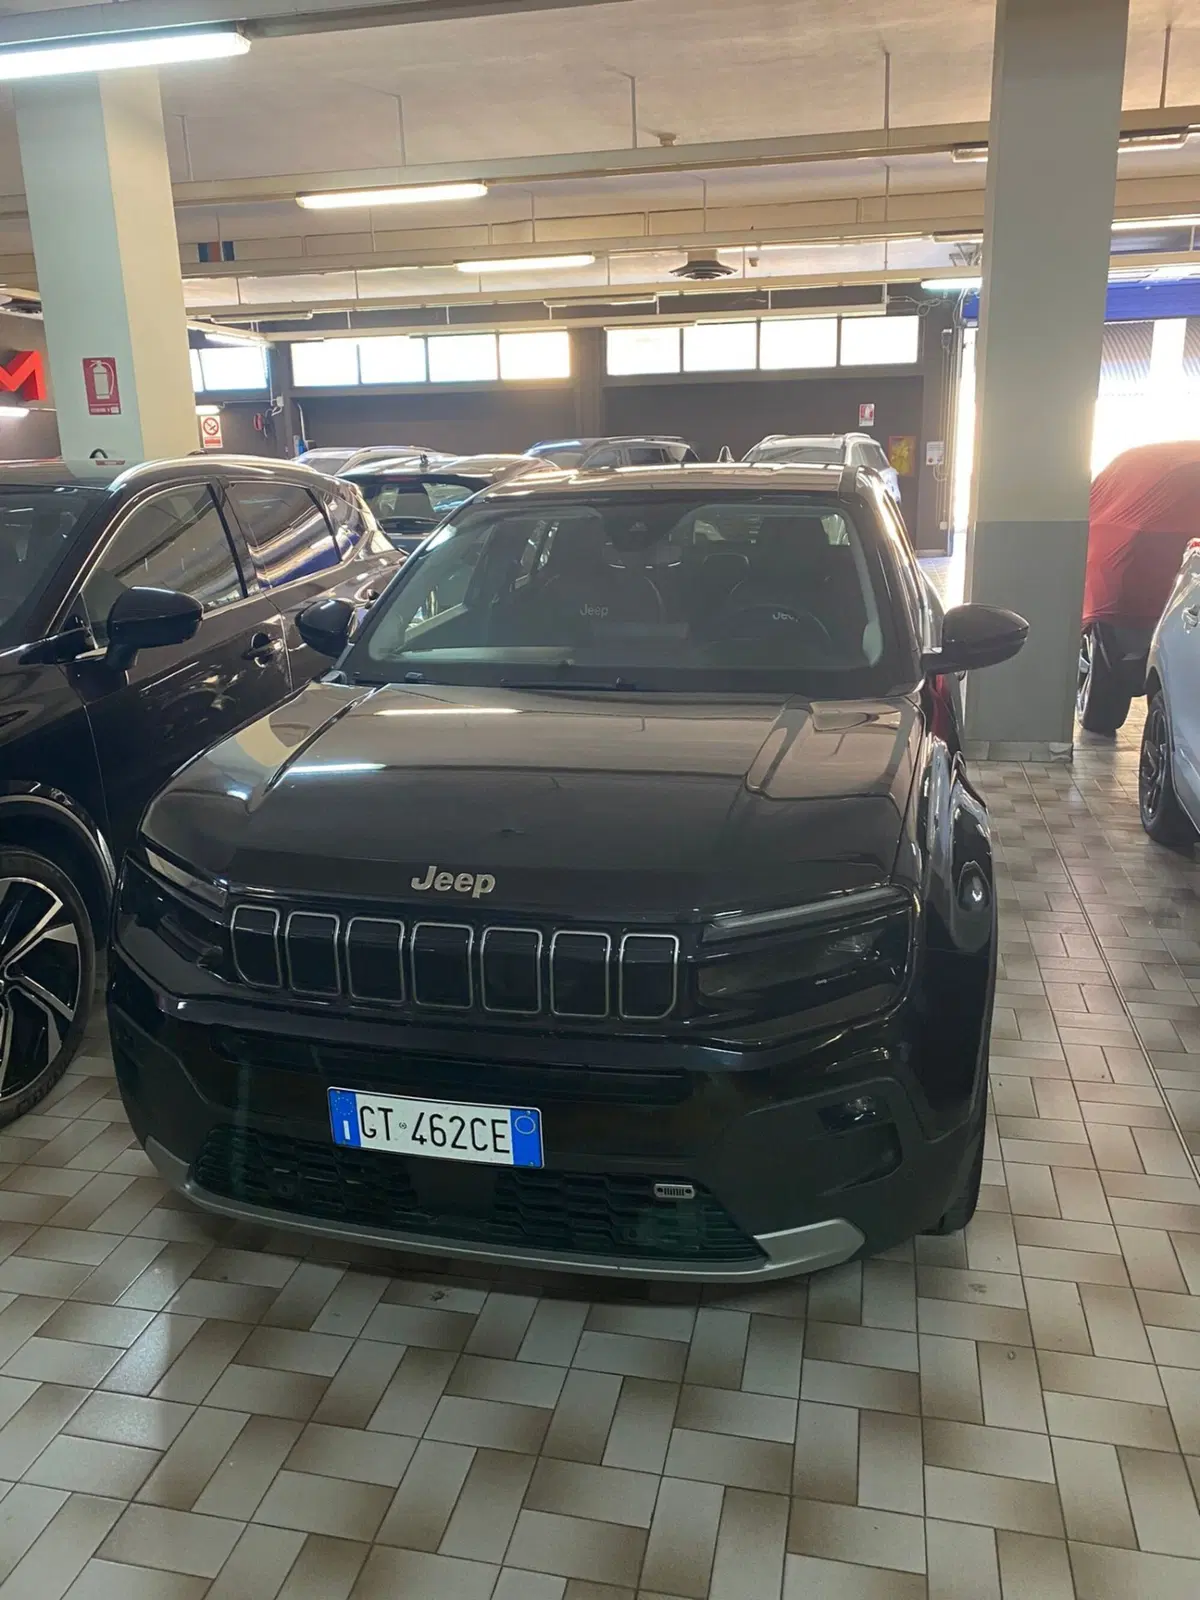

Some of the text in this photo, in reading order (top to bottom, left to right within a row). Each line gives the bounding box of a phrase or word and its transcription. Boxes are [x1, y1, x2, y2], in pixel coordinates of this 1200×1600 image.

[579, 603, 609, 619] Jeep
[772, 611, 800, 624] Je
[410, 865, 496, 899] Jeep
[359, 1105, 394, 1142] GT
[411, 1112, 510, 1154] 462CE
